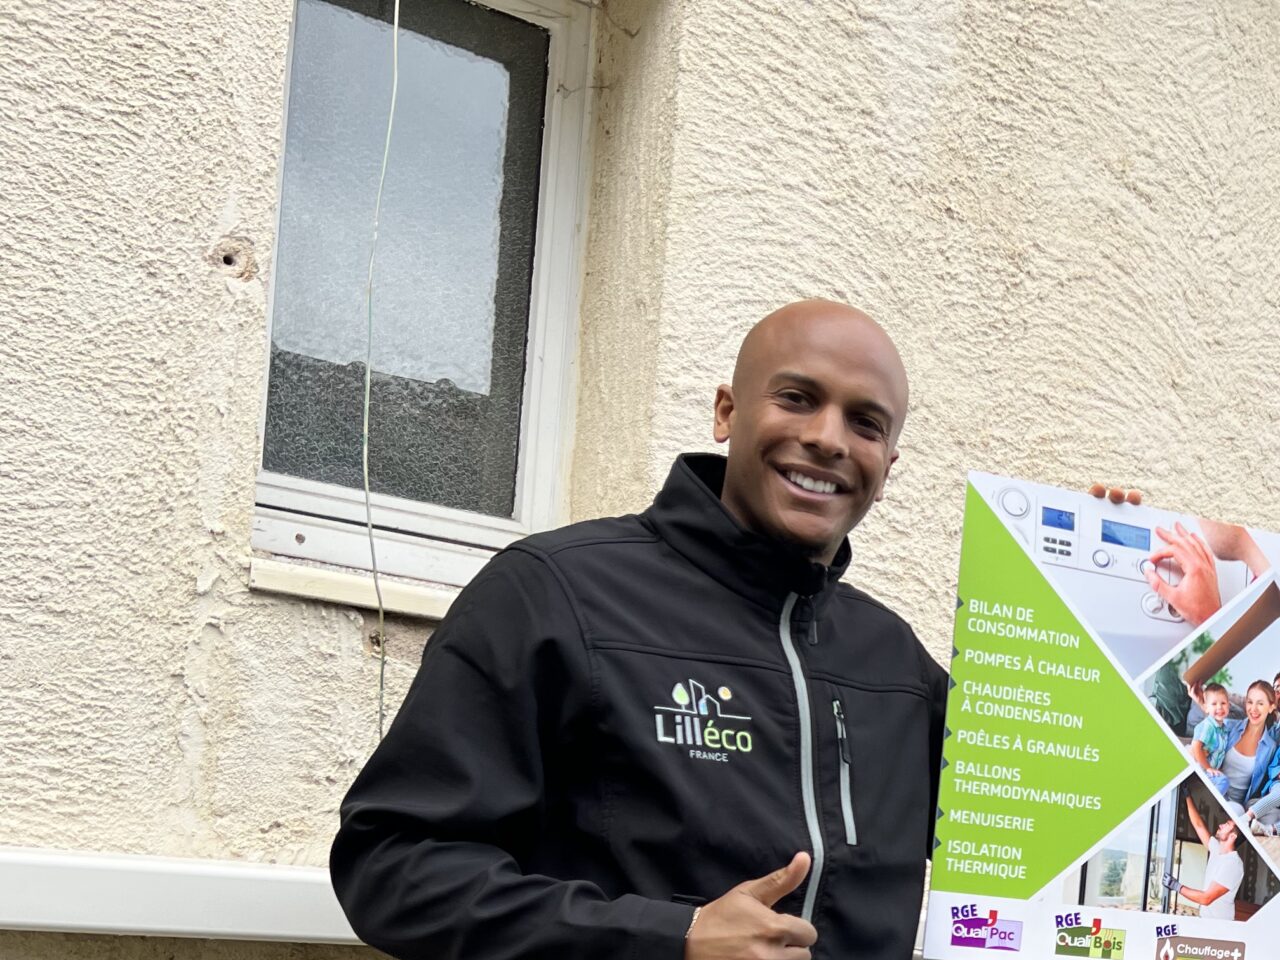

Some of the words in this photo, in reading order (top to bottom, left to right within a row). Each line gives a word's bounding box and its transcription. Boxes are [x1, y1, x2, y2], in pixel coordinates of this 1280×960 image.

[968, 599, 1012, 621] BILAN
[1015, 604, 1034, 623] DE
[967, 617, 1080, 649] CONSOMMATION
[964, 650, 1021, 671] POMPES
[1024, 654, 1035, 673] À
[1038, 660, 1100, 683] CHALEUR
[963, 680, 1051, 706] CHAUDIÈRES
[961, 694, 972, 712] À
[975, 702, 1083, 729] CONDENSATION
[655, 714, 752, 752] Lilléco
[689, 749, 729, 762] FRANCE
[957, 729, 1010, 751] POÊLES
[1012, 731, 1023, 751] À
[1027, 741, 1100, 762] GRANULÉS
[955, 760, 1021, 782] BALLONS
[953, 778, 1101, 810] THERMODYNAMIQUES
[950, 809, 1034, 831] MENUISERIE
[947, 840, 1022, 861] ISOLATION
[946, 858, 1027, 879] THERMIQUE
[951, 904, 978, 919] RGE
[1055, 912, 1082, 928] RGE
[1156, 924, 1177, 938] RGE
